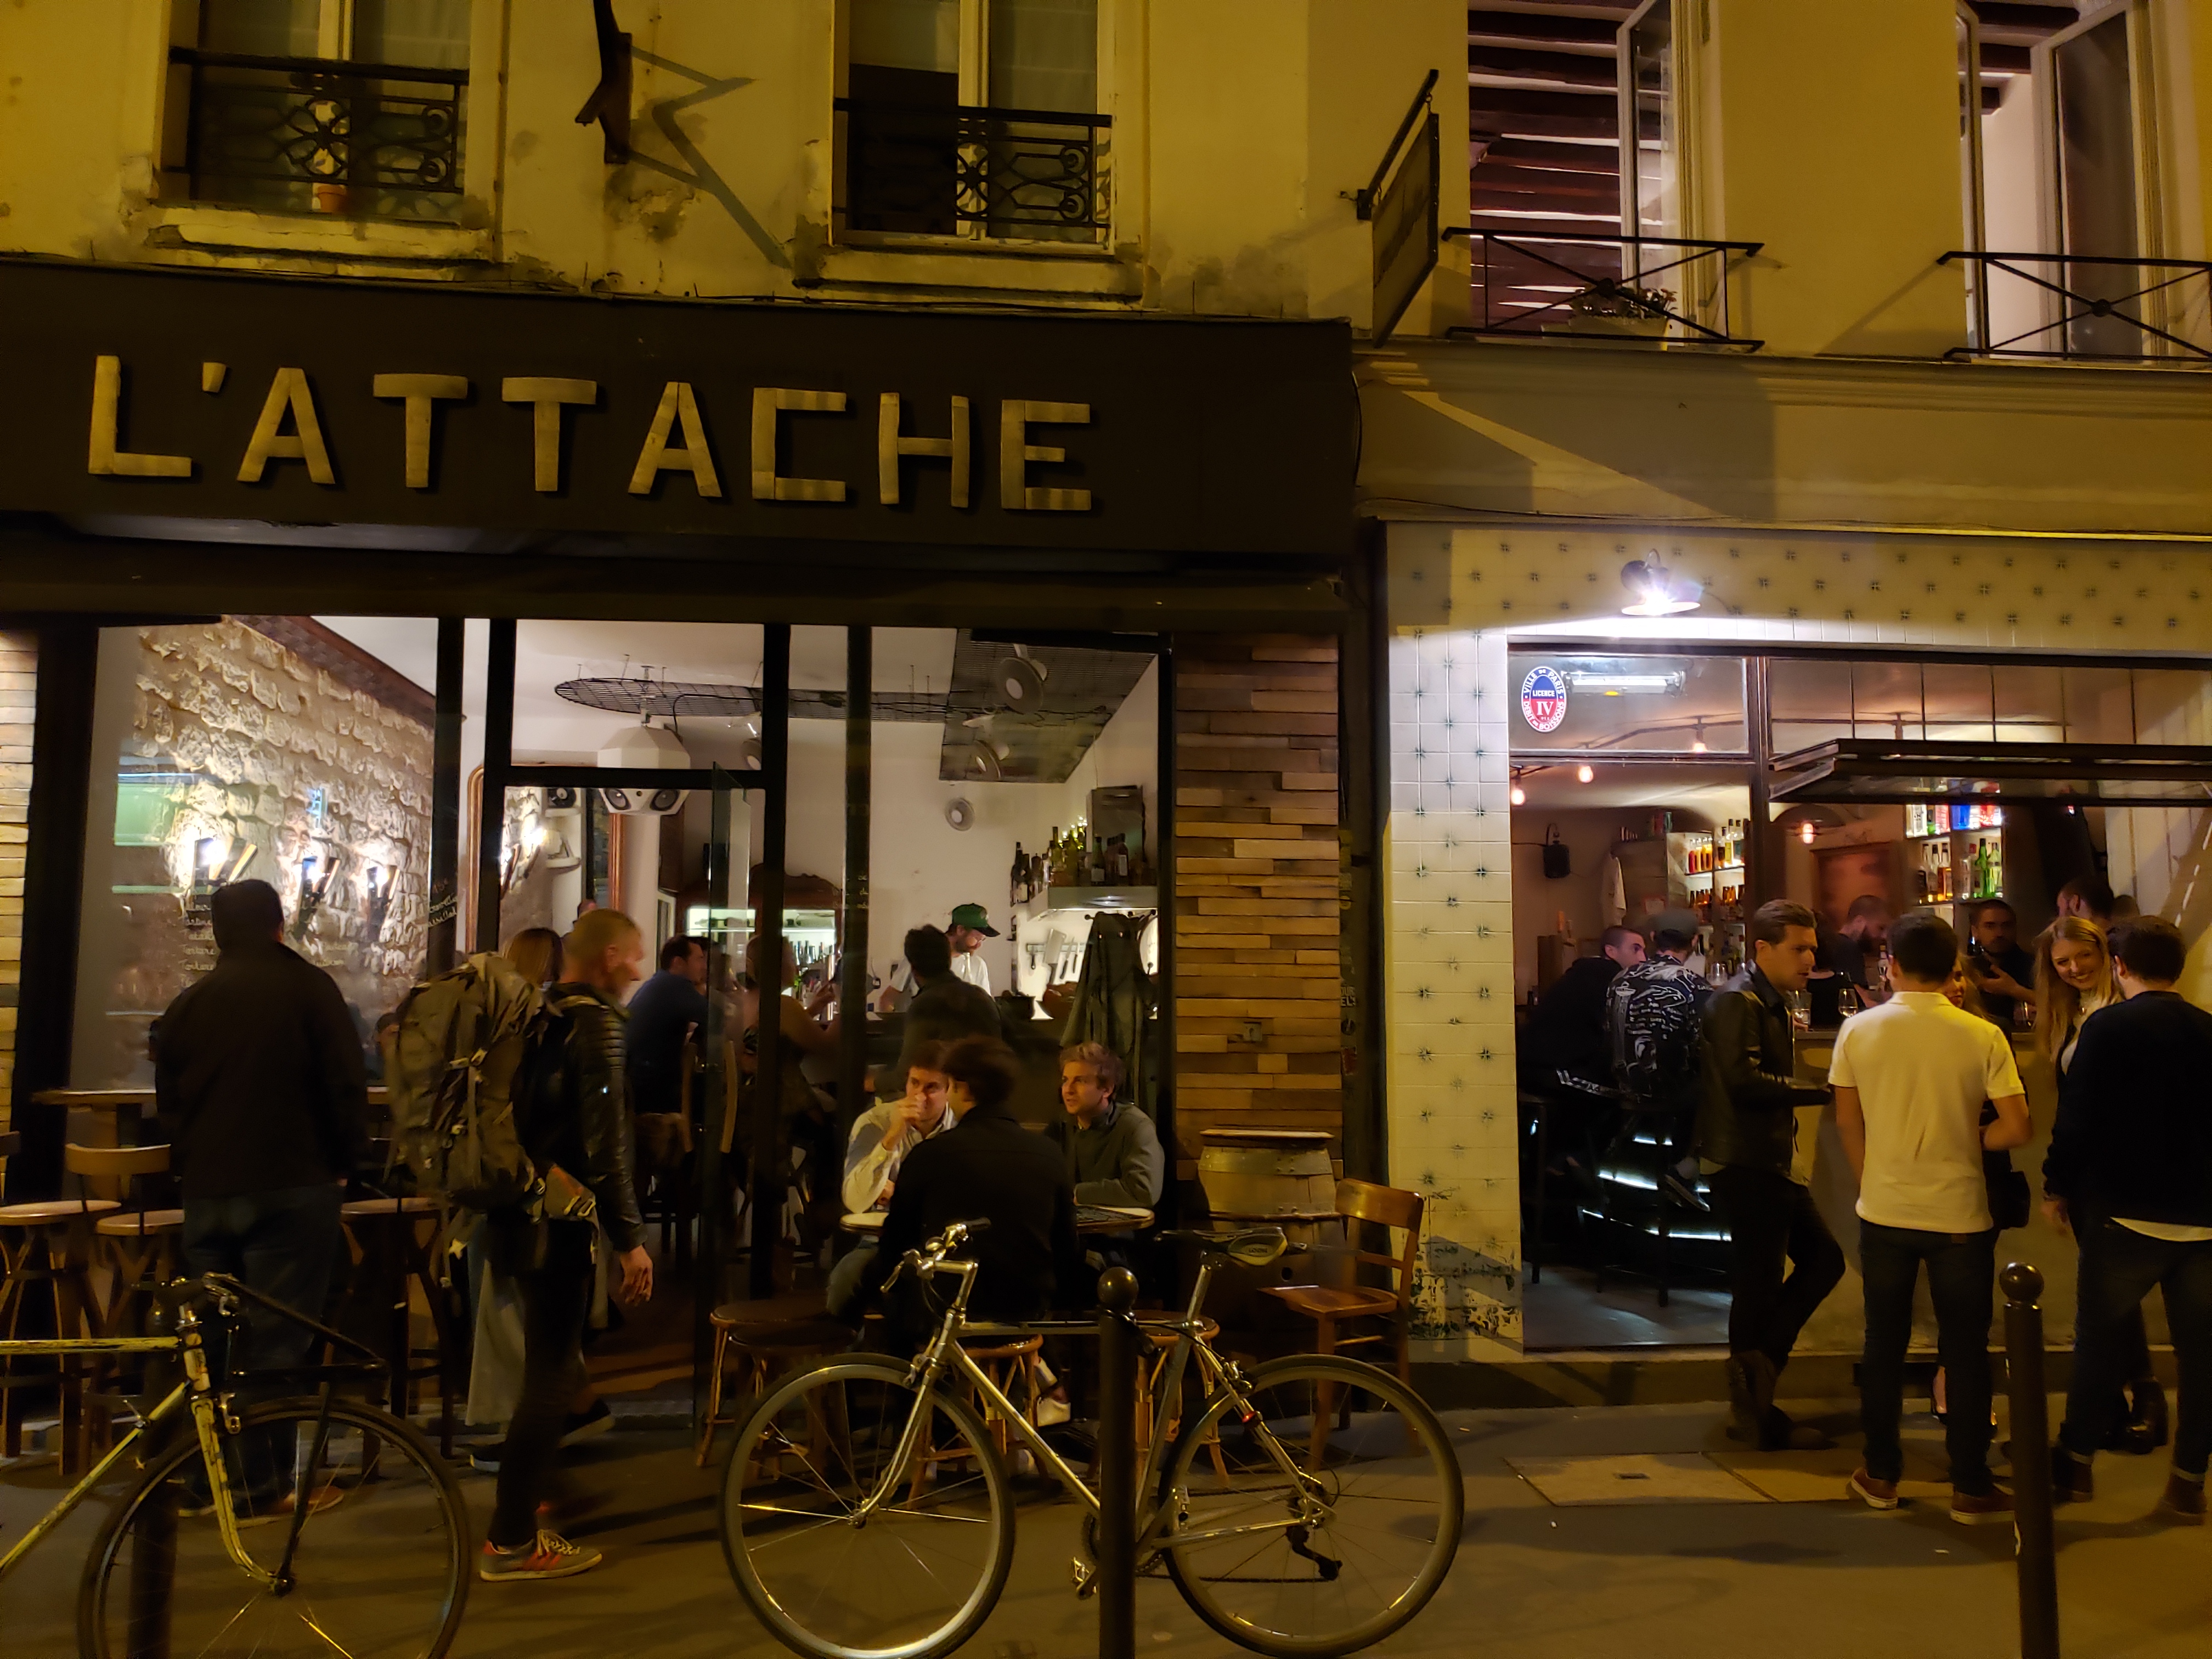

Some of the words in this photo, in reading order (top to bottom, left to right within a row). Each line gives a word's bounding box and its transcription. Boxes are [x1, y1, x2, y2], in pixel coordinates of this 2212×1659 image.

[87, 354, 1092, 512] L'ATTACHE
[1523, 673, 1538, 693] VILLE
[1548, 671, 1564, 695] PARIS
[1537, 701, 1554, 716] IV
[1539, 701, 1564, 730] BOISSONS
